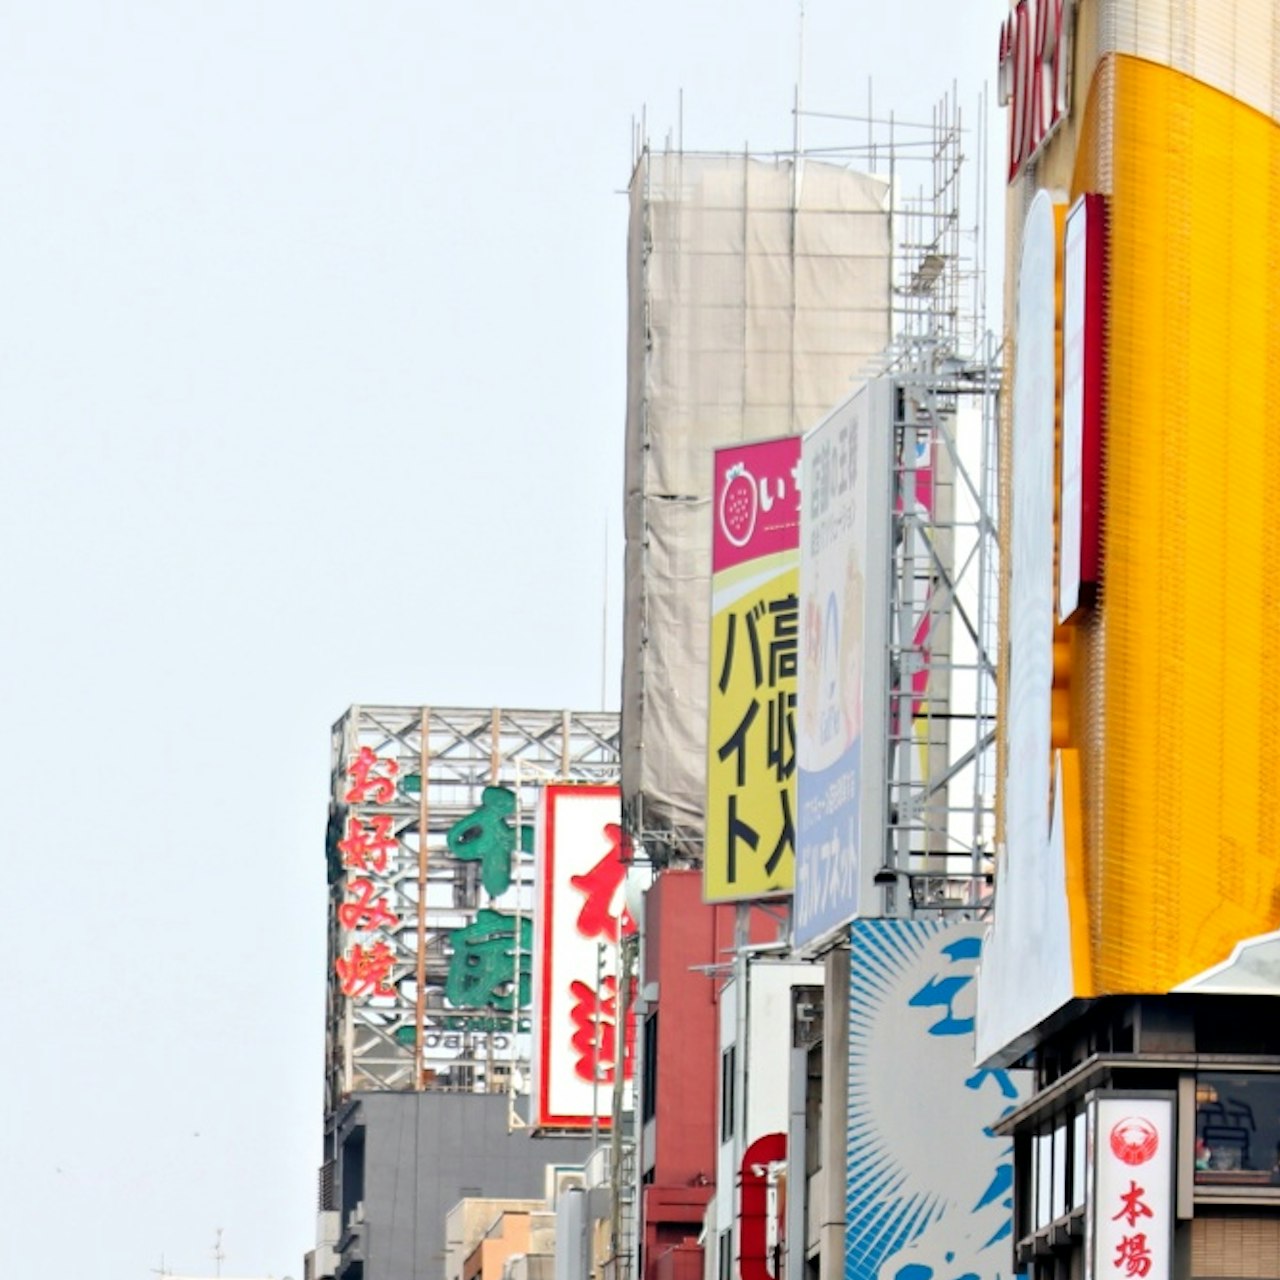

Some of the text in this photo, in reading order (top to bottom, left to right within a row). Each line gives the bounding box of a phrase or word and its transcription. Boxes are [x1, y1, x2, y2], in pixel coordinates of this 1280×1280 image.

[336, 745, 399, 999] お好み焼
[717, 608, 763, 885] バイト
